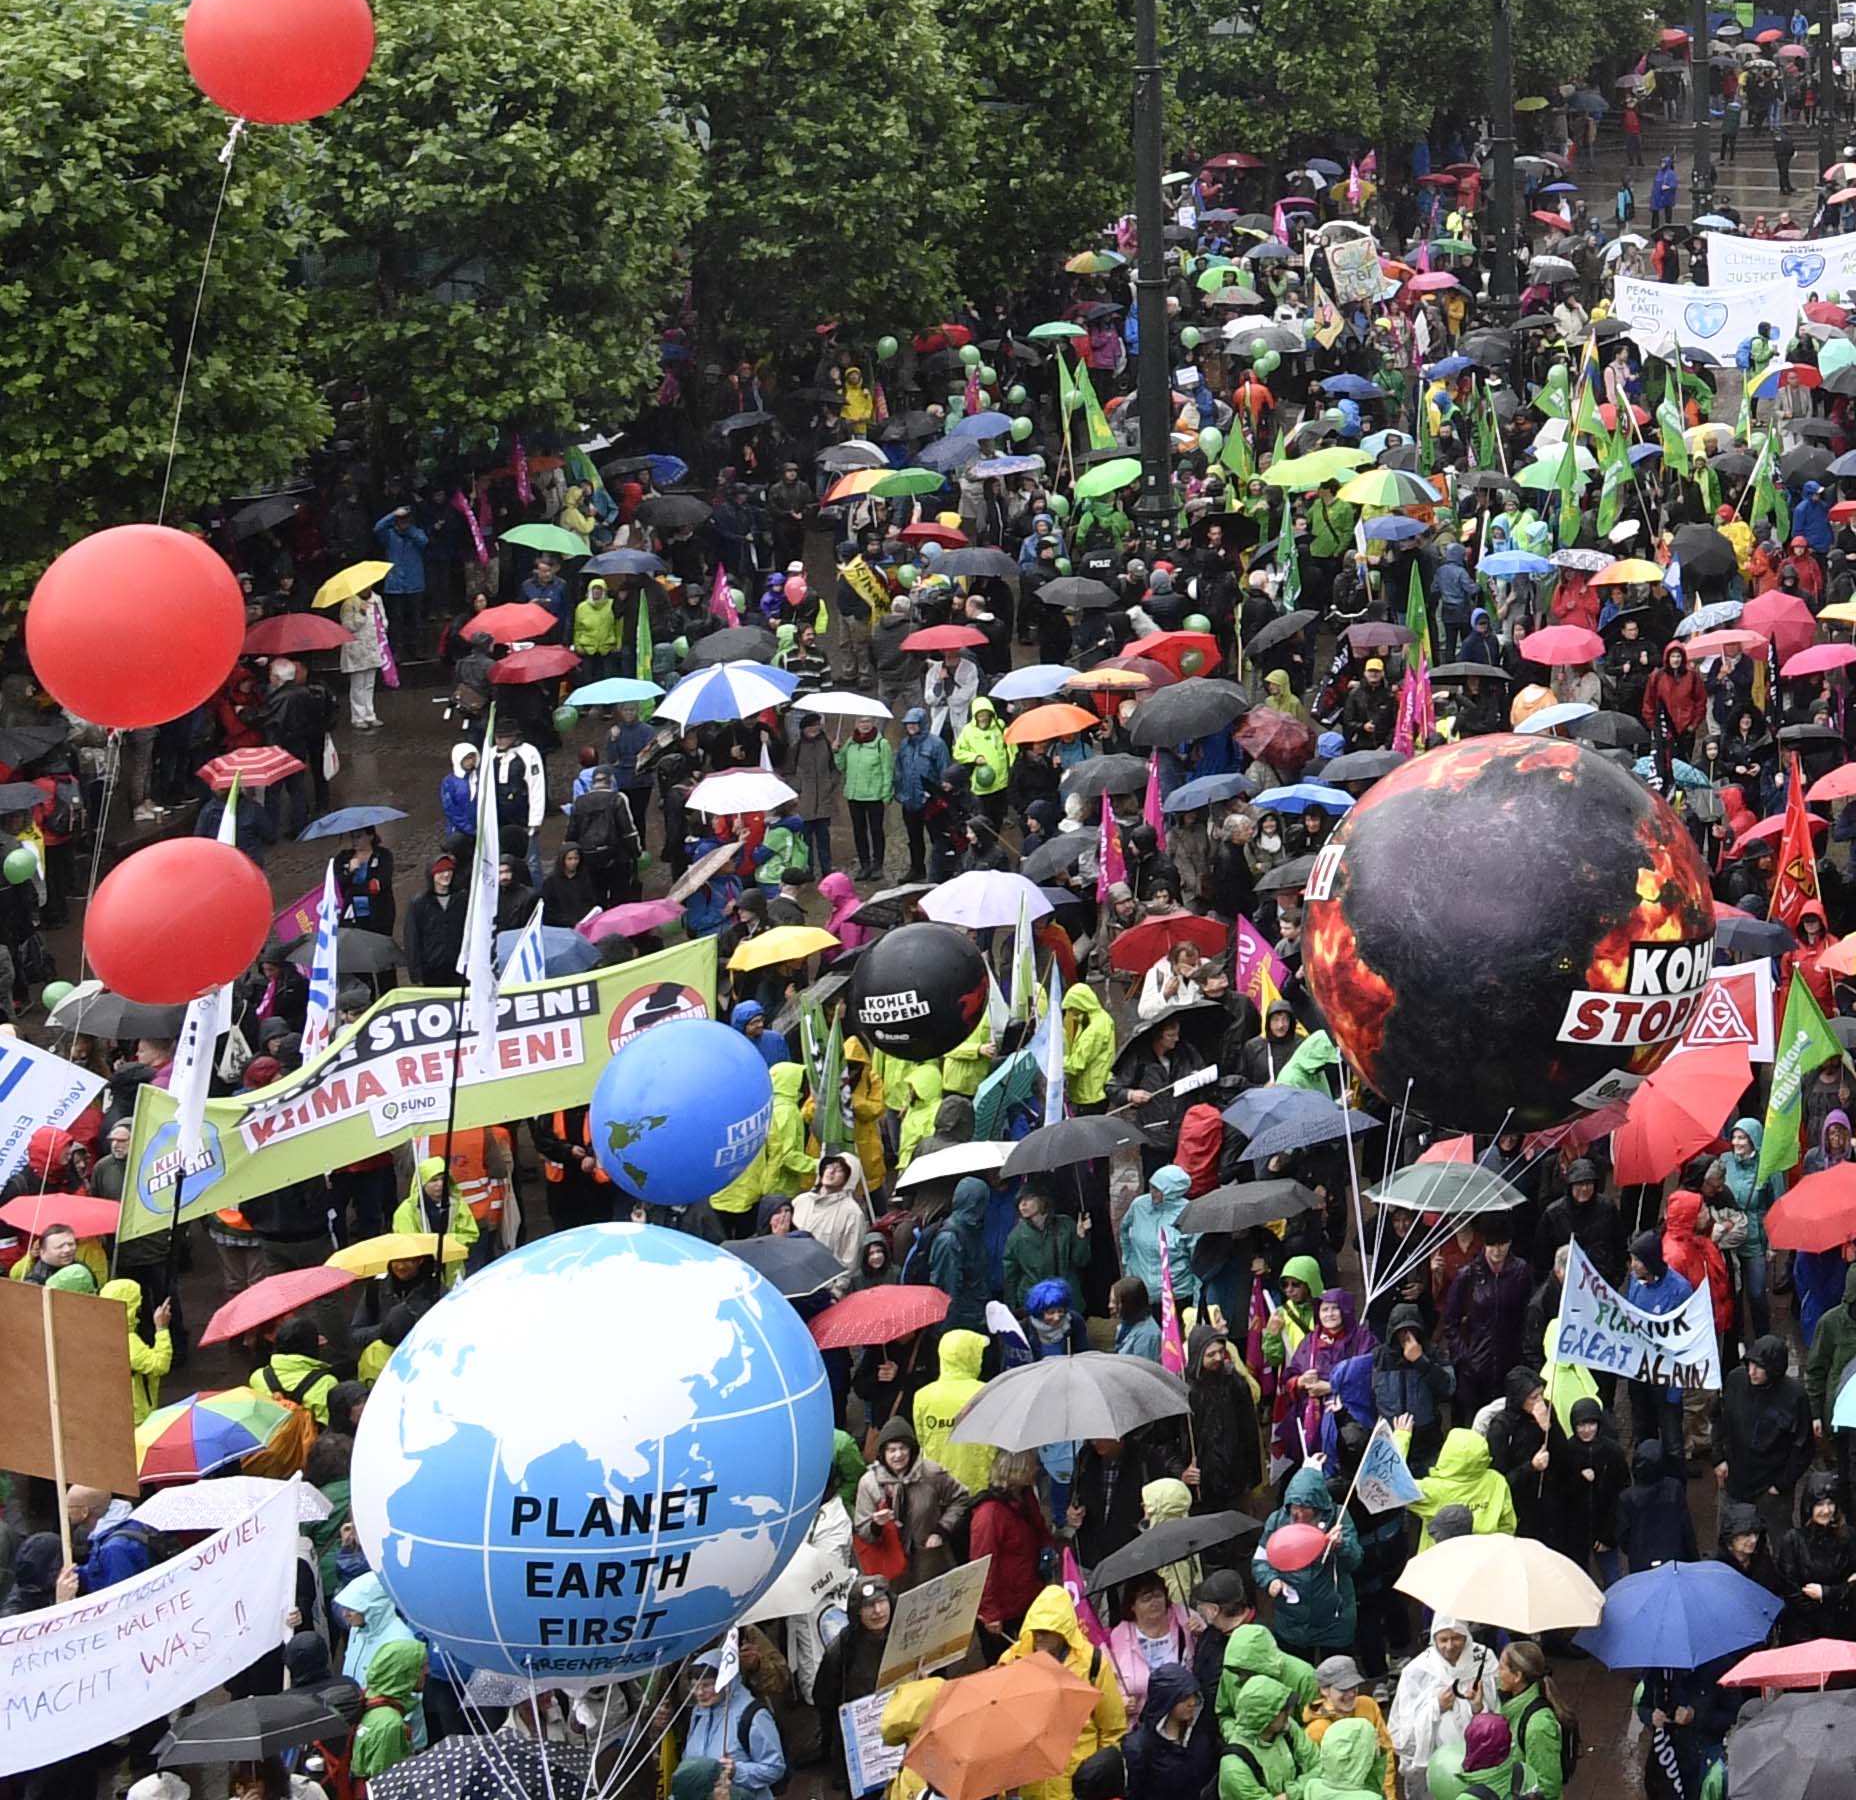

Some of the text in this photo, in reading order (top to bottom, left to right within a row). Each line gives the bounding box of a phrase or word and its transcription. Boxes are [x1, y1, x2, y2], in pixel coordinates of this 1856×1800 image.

[861, 1003, 927, 1022] STOPPEN!
[868, 993, 913, 1010] KOHLE
[396, 1027, 574, 1089] RETEN!
[1558, 1323, 1711, 1390] GREAT AGAIN
[938, 1418, 955, 1428] BU
[511, 1485, 719, 1538] PLANET
[525, 1553, 701, 1600] EARTH
[538, 1609, 668, 1647] FIRST
[5, 1666, 121, 1731] MACHT
[140, 1617, 212, 1675] WAS
